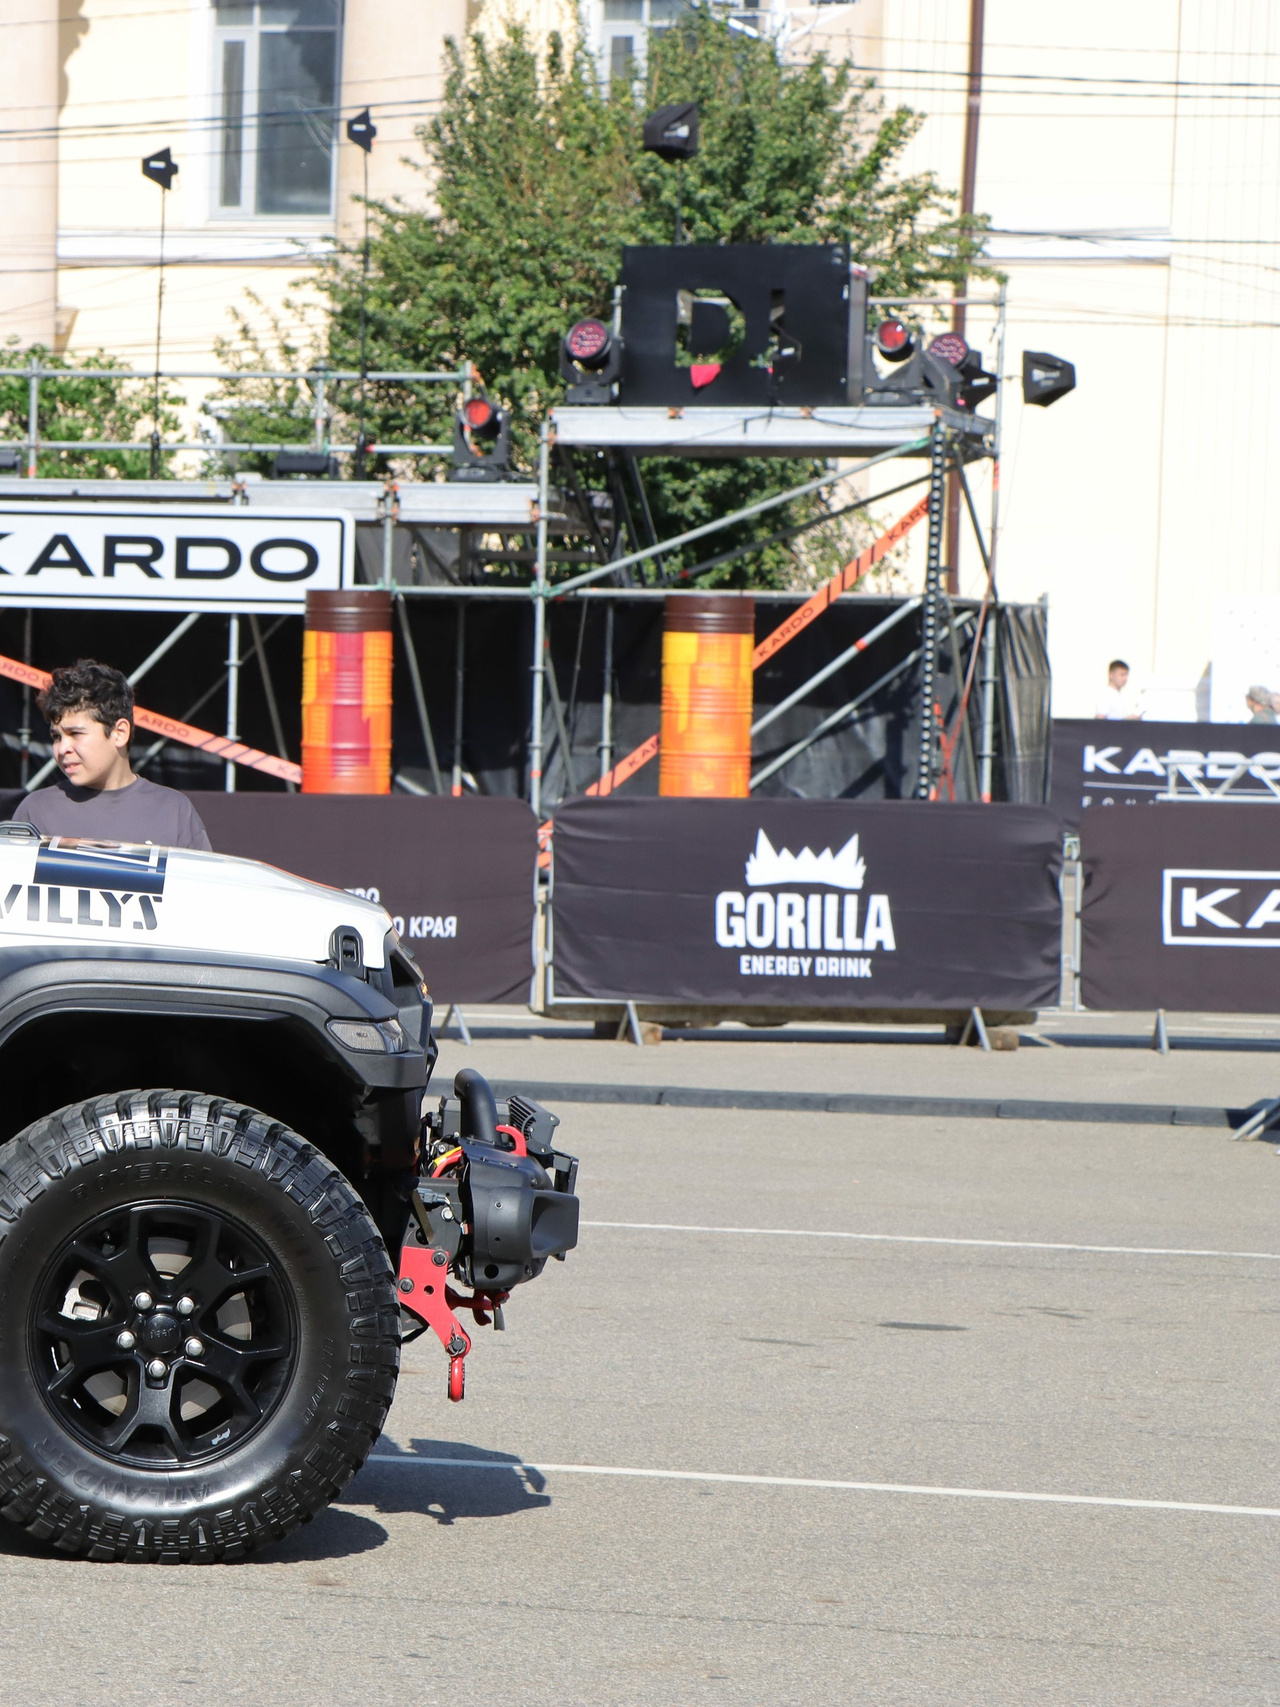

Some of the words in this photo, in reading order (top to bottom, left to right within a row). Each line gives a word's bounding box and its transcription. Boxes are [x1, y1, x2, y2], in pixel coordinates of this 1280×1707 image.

[887, 501, 928, 541] KARD
[758, 606, 814, 658] KARDO
[139, 714, 190, 738] ARDO
[409, 916, 457, 938] КРАЯ
[715, 891, 896, 951] GORILLA
[740, 955, 812, 977] ENERGY
[815, 957, 872, 978] DRINK
[34, 1437, 210, 1507] ATLANDER
